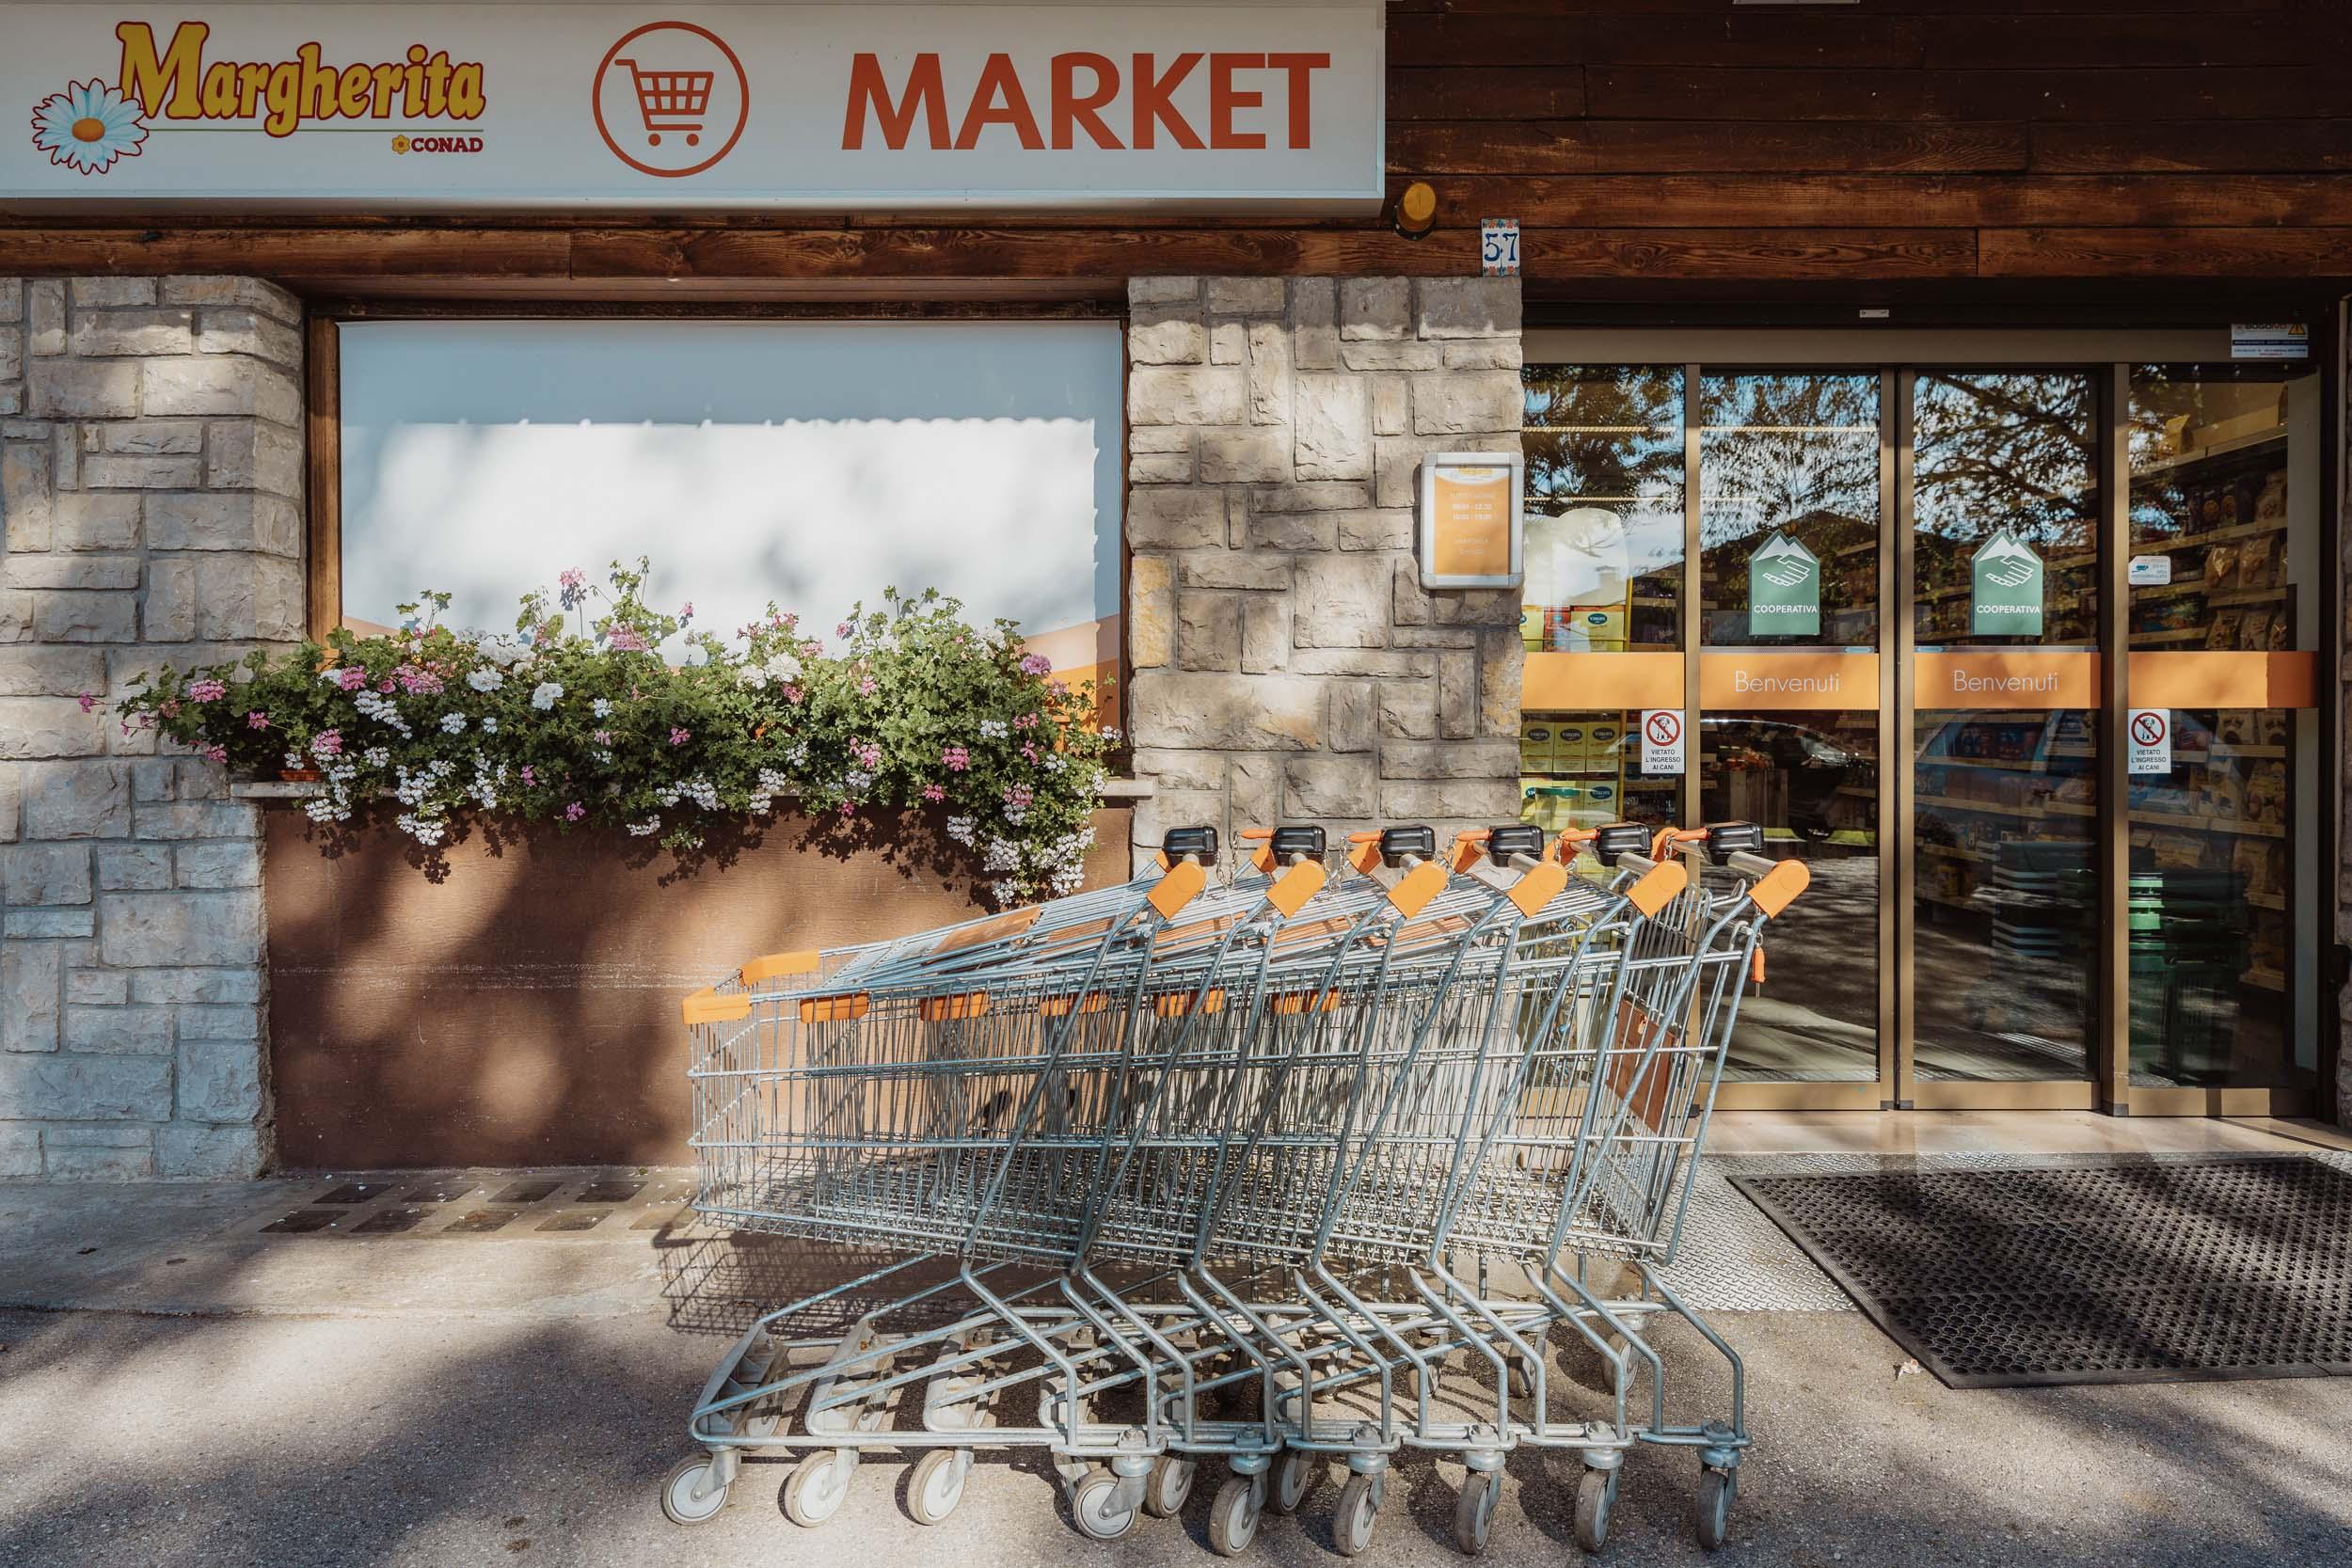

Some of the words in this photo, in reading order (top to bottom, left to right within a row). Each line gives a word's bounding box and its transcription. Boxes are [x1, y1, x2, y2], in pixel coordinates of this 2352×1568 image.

[116, 21, 486, 137] Margherita
[841, 52, 1330, 150] MARKET
[410, 137, 484, 153] CONAD
[1484, 232, 1518, 261] 57
[1754, 605, 1818, 613] COOPERATIVA
[1976, 605, 2041, 614] COOPERATIVA
[1735, 670, 1840, 692] Benvenuti
[1954, 669, 2058, 692] Benvenuti
